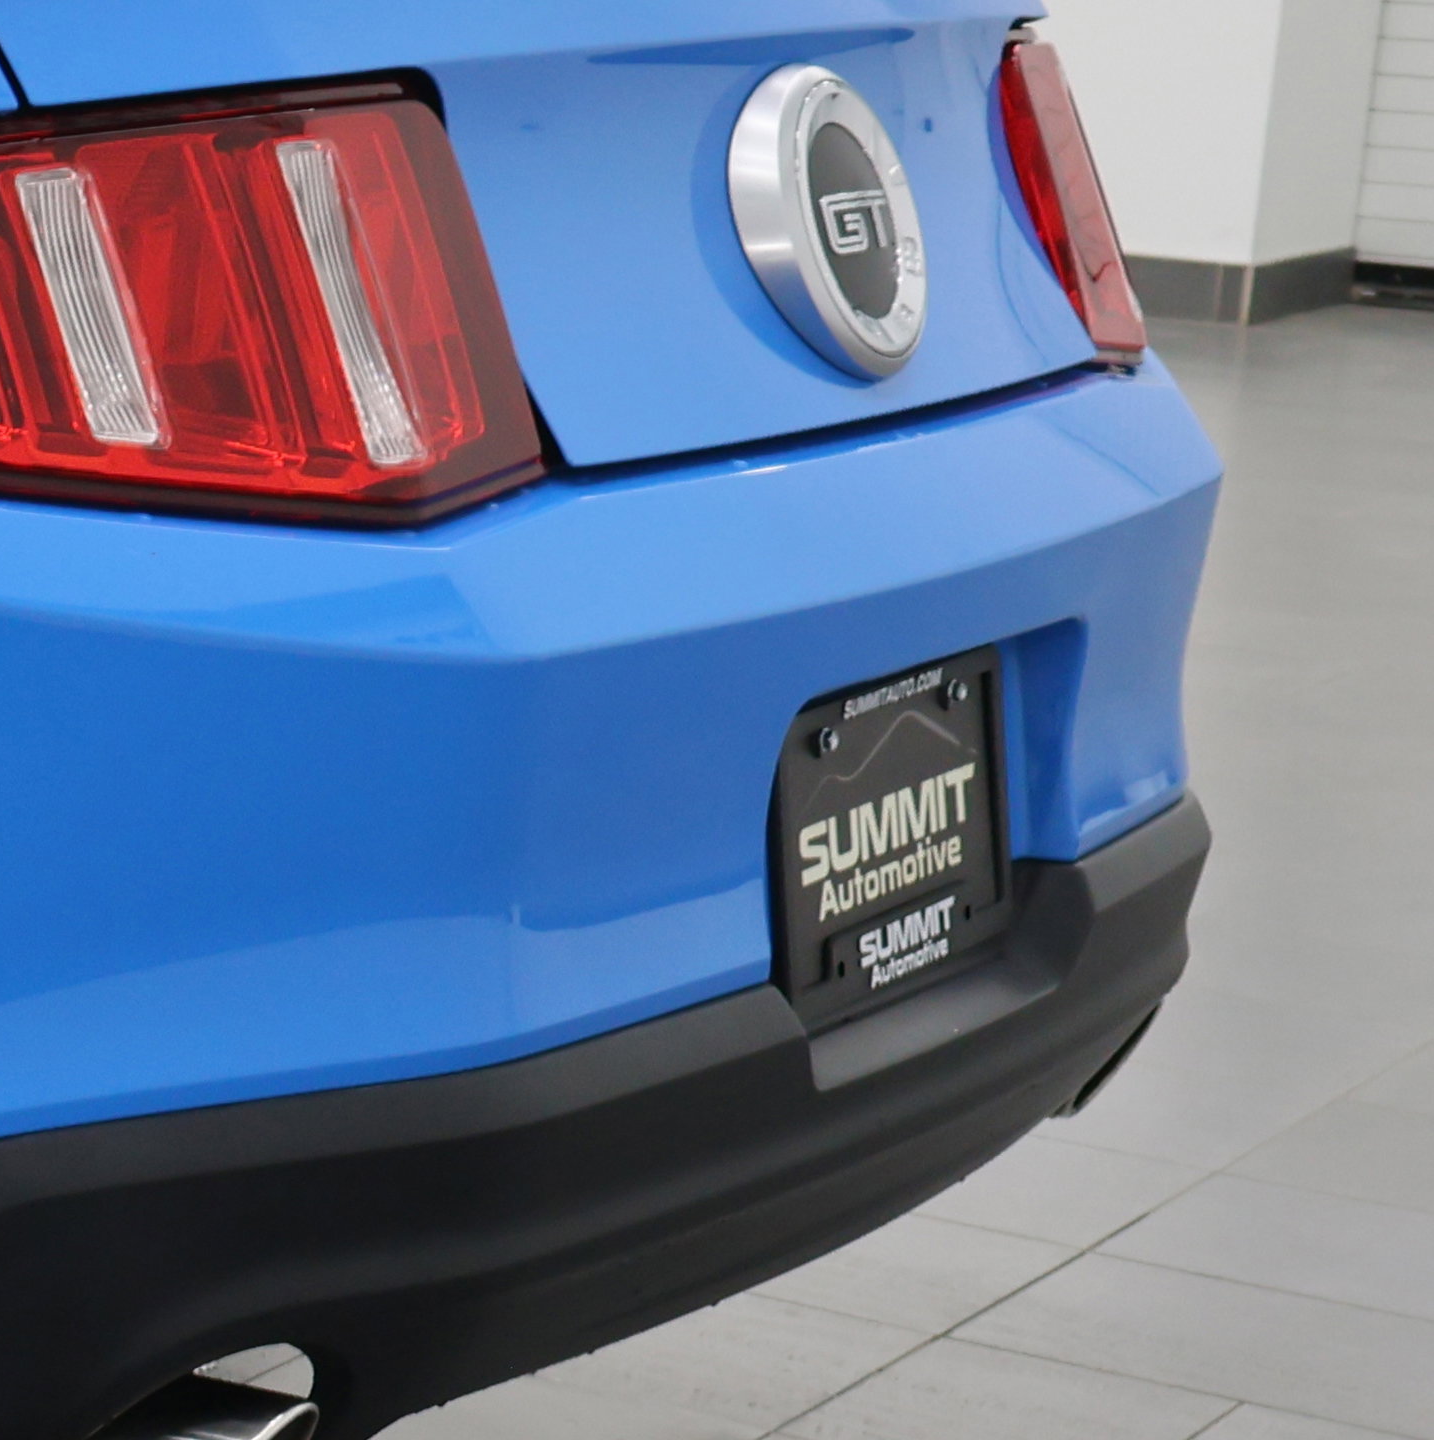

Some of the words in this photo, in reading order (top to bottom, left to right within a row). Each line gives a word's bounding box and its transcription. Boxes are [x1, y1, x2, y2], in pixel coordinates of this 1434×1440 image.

[818, 189, 887, 254] GT
[843, 668, 943, 720] SUMMITAUTO.COM
[800, 762, 975, 887] SUMMIT
[819, 835, 962, 922] Automotive
[859, 896, 955, 968] SUMMIT
[871, 938, 948, 990] Automotive
